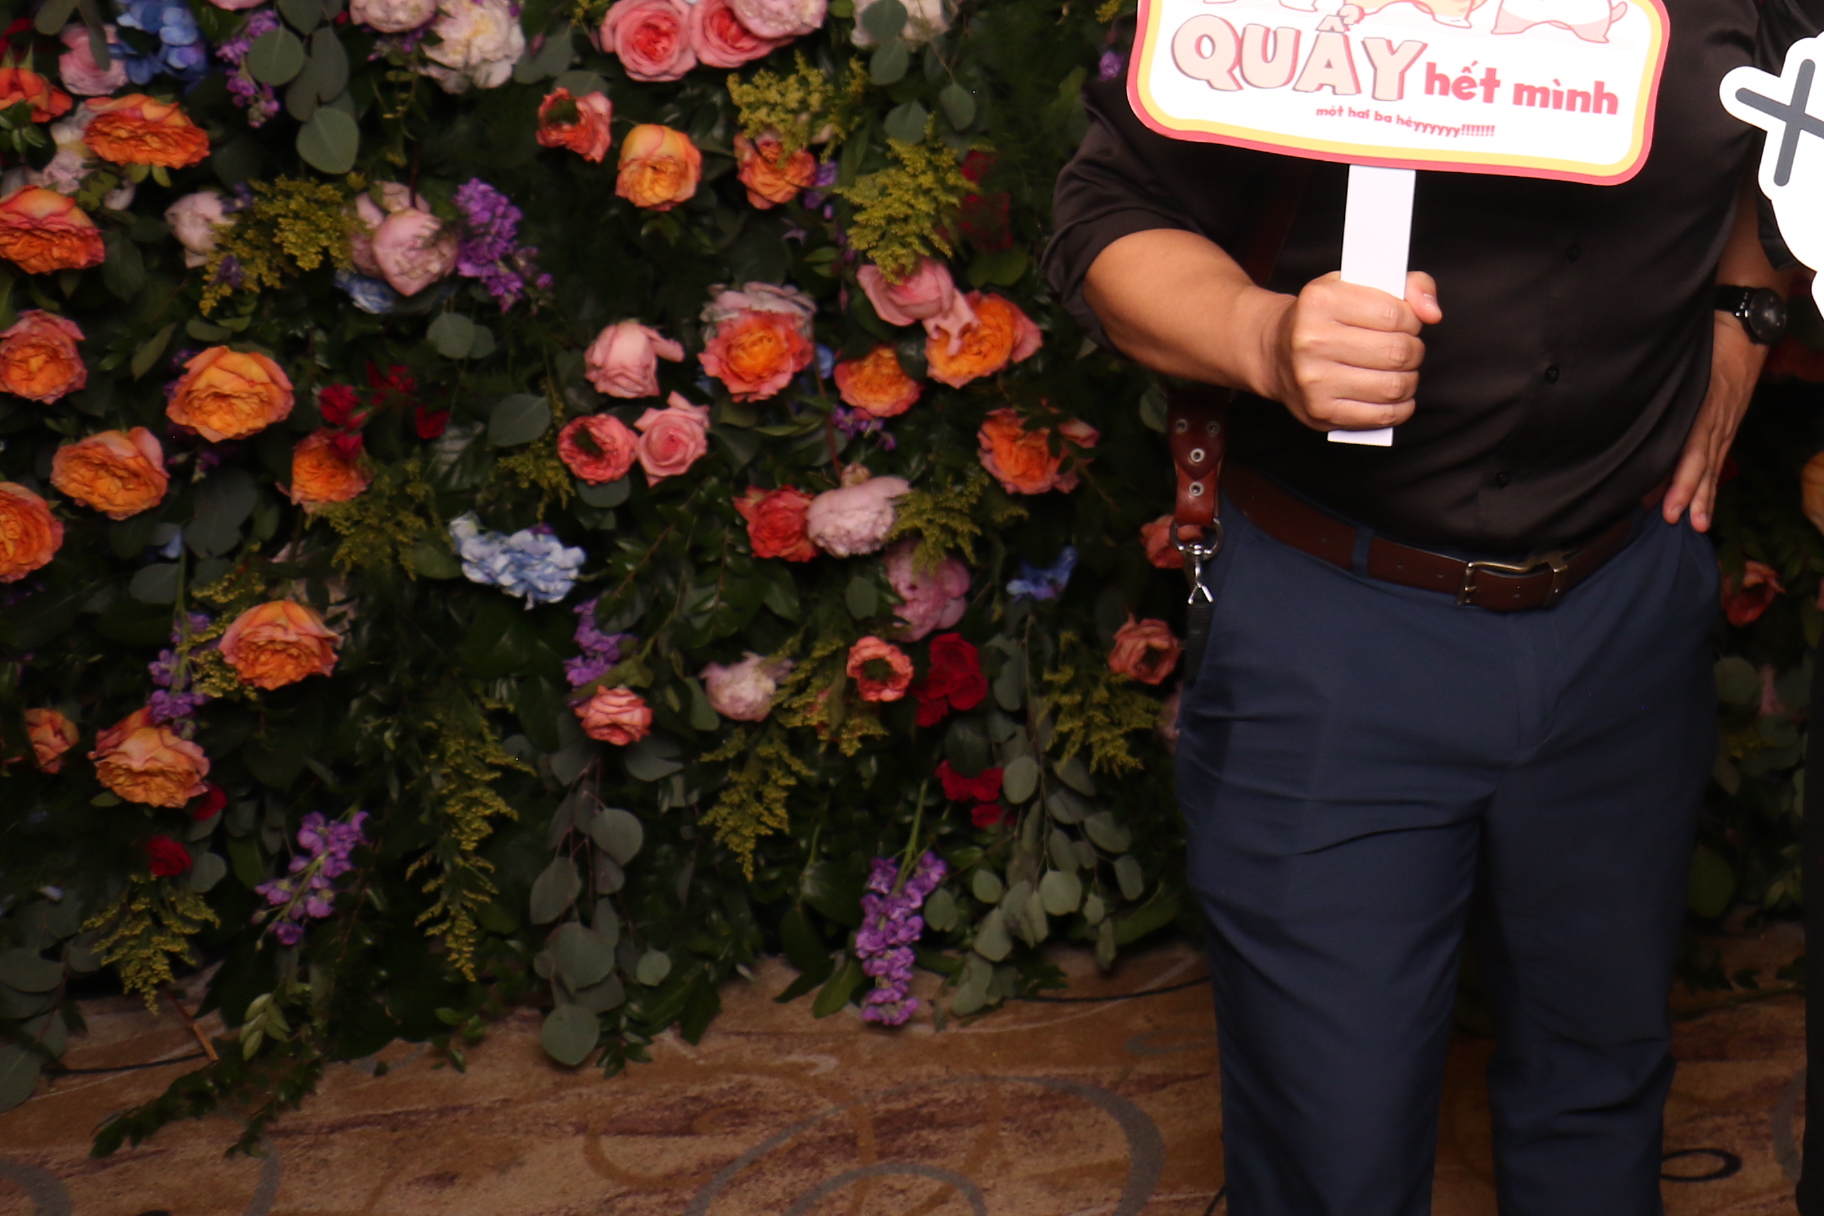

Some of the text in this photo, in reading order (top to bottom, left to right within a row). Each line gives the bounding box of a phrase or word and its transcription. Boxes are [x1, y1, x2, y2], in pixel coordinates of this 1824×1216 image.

[1424, 60, 1502, 104] hết
[1512, 78, 1619, 115] mình
[1316, 105, 1344, 118] một
[1374, 110, 1393, 123] ba
